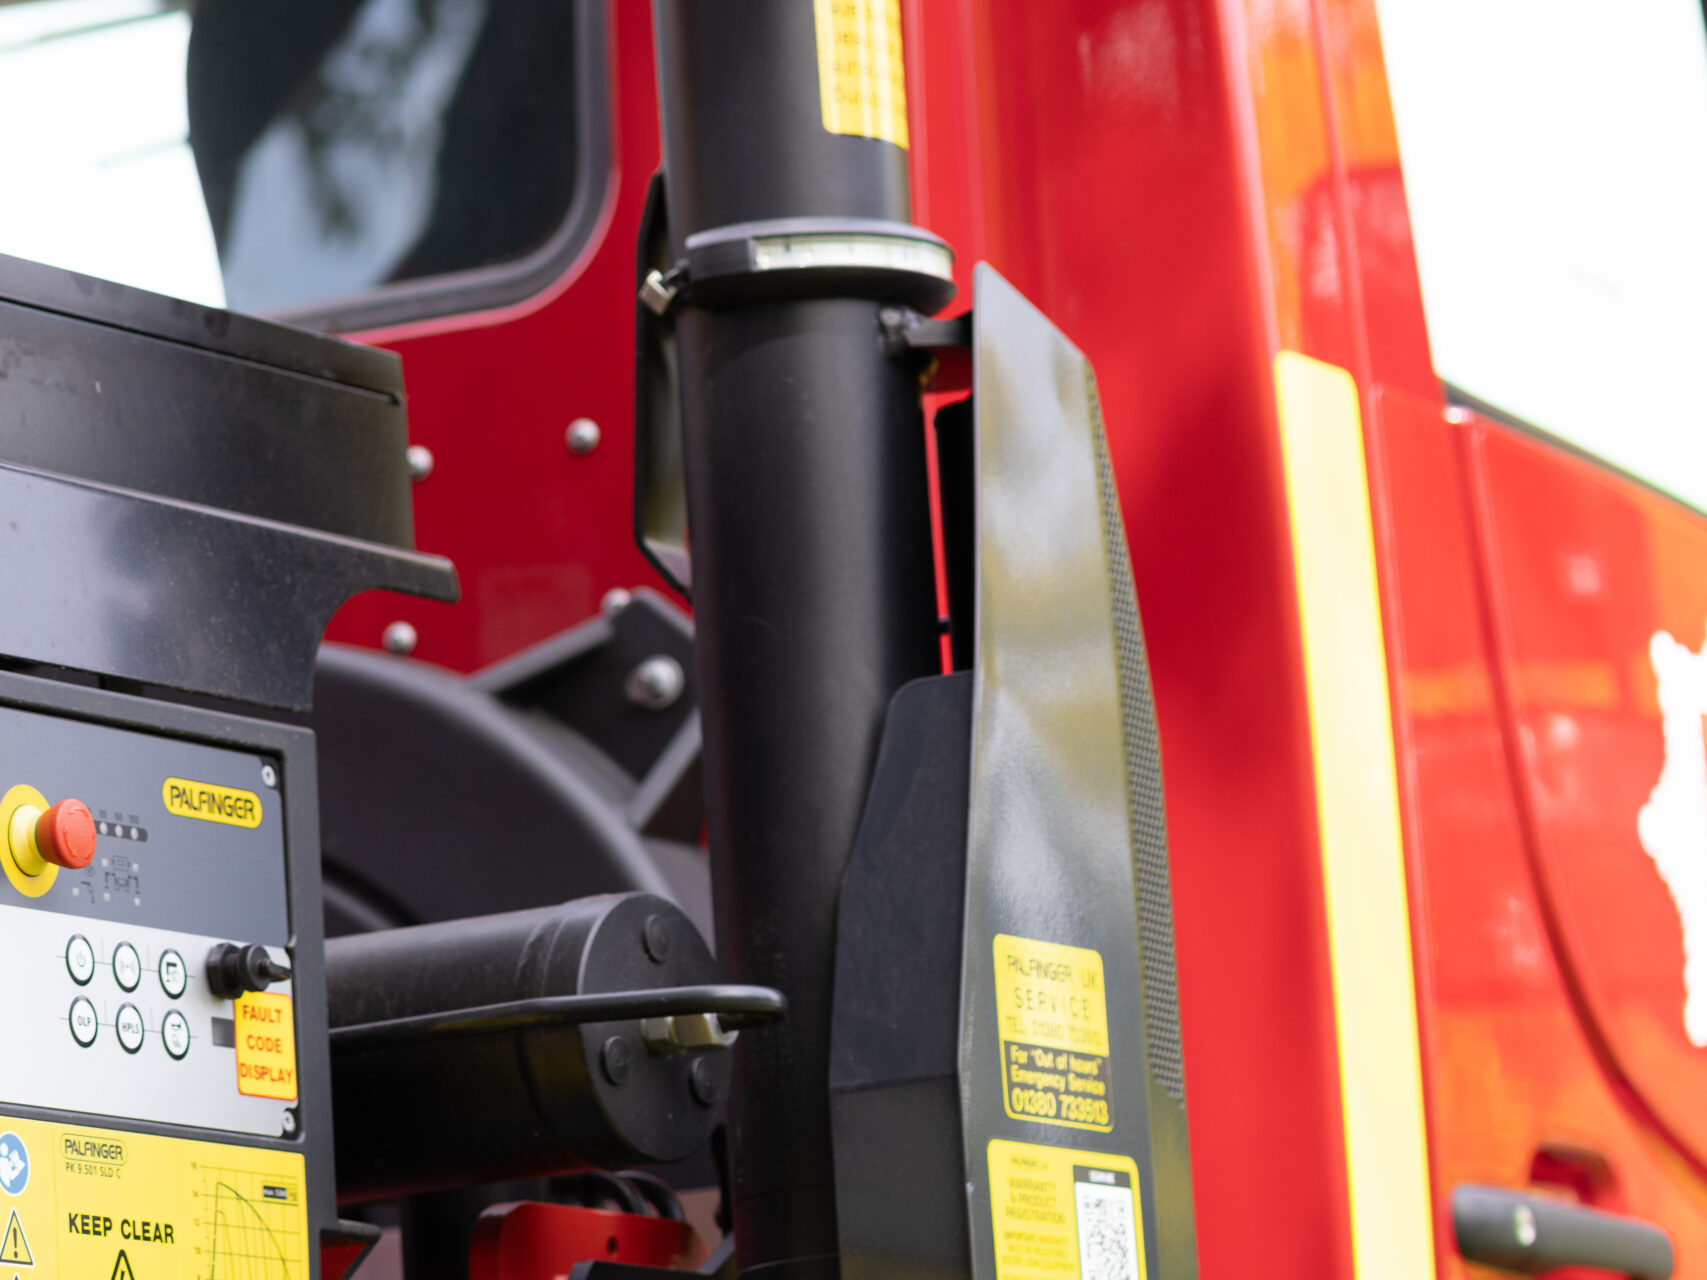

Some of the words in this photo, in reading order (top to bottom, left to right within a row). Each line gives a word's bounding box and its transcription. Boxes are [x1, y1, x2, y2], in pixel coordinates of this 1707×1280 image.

[170, 784, 255, 821] PALFINGER
[1007, 954, 1073, 984] PALFINGER
[242, 1004, 282, 1024] FAULT
[1014, 986, 1091, 1020] SERVICE
[121, 1022, 140, 1034] HPLS
[246, 1034, 282, 1054] CODE
[1010, 1045, 1028, 1064] For
[1055, 1053, 1068, 1070] of
[240, 1063, 294, 1084] DISPLAY
[1010, 1064, 1067, 1092] Emergency
[1067, 1072, 1106, 1096] Service
[1011, 1087, 1057, 1117] 01380
[64, 1139, 123, 1161] PALFINGER
[65, 1162, 75, 1174] PK
[99, 1166, 114, 1178] SLD
[68, 1212, 112, 1237] KEEP
[120, 1219, 175, 1245] CLEAR
